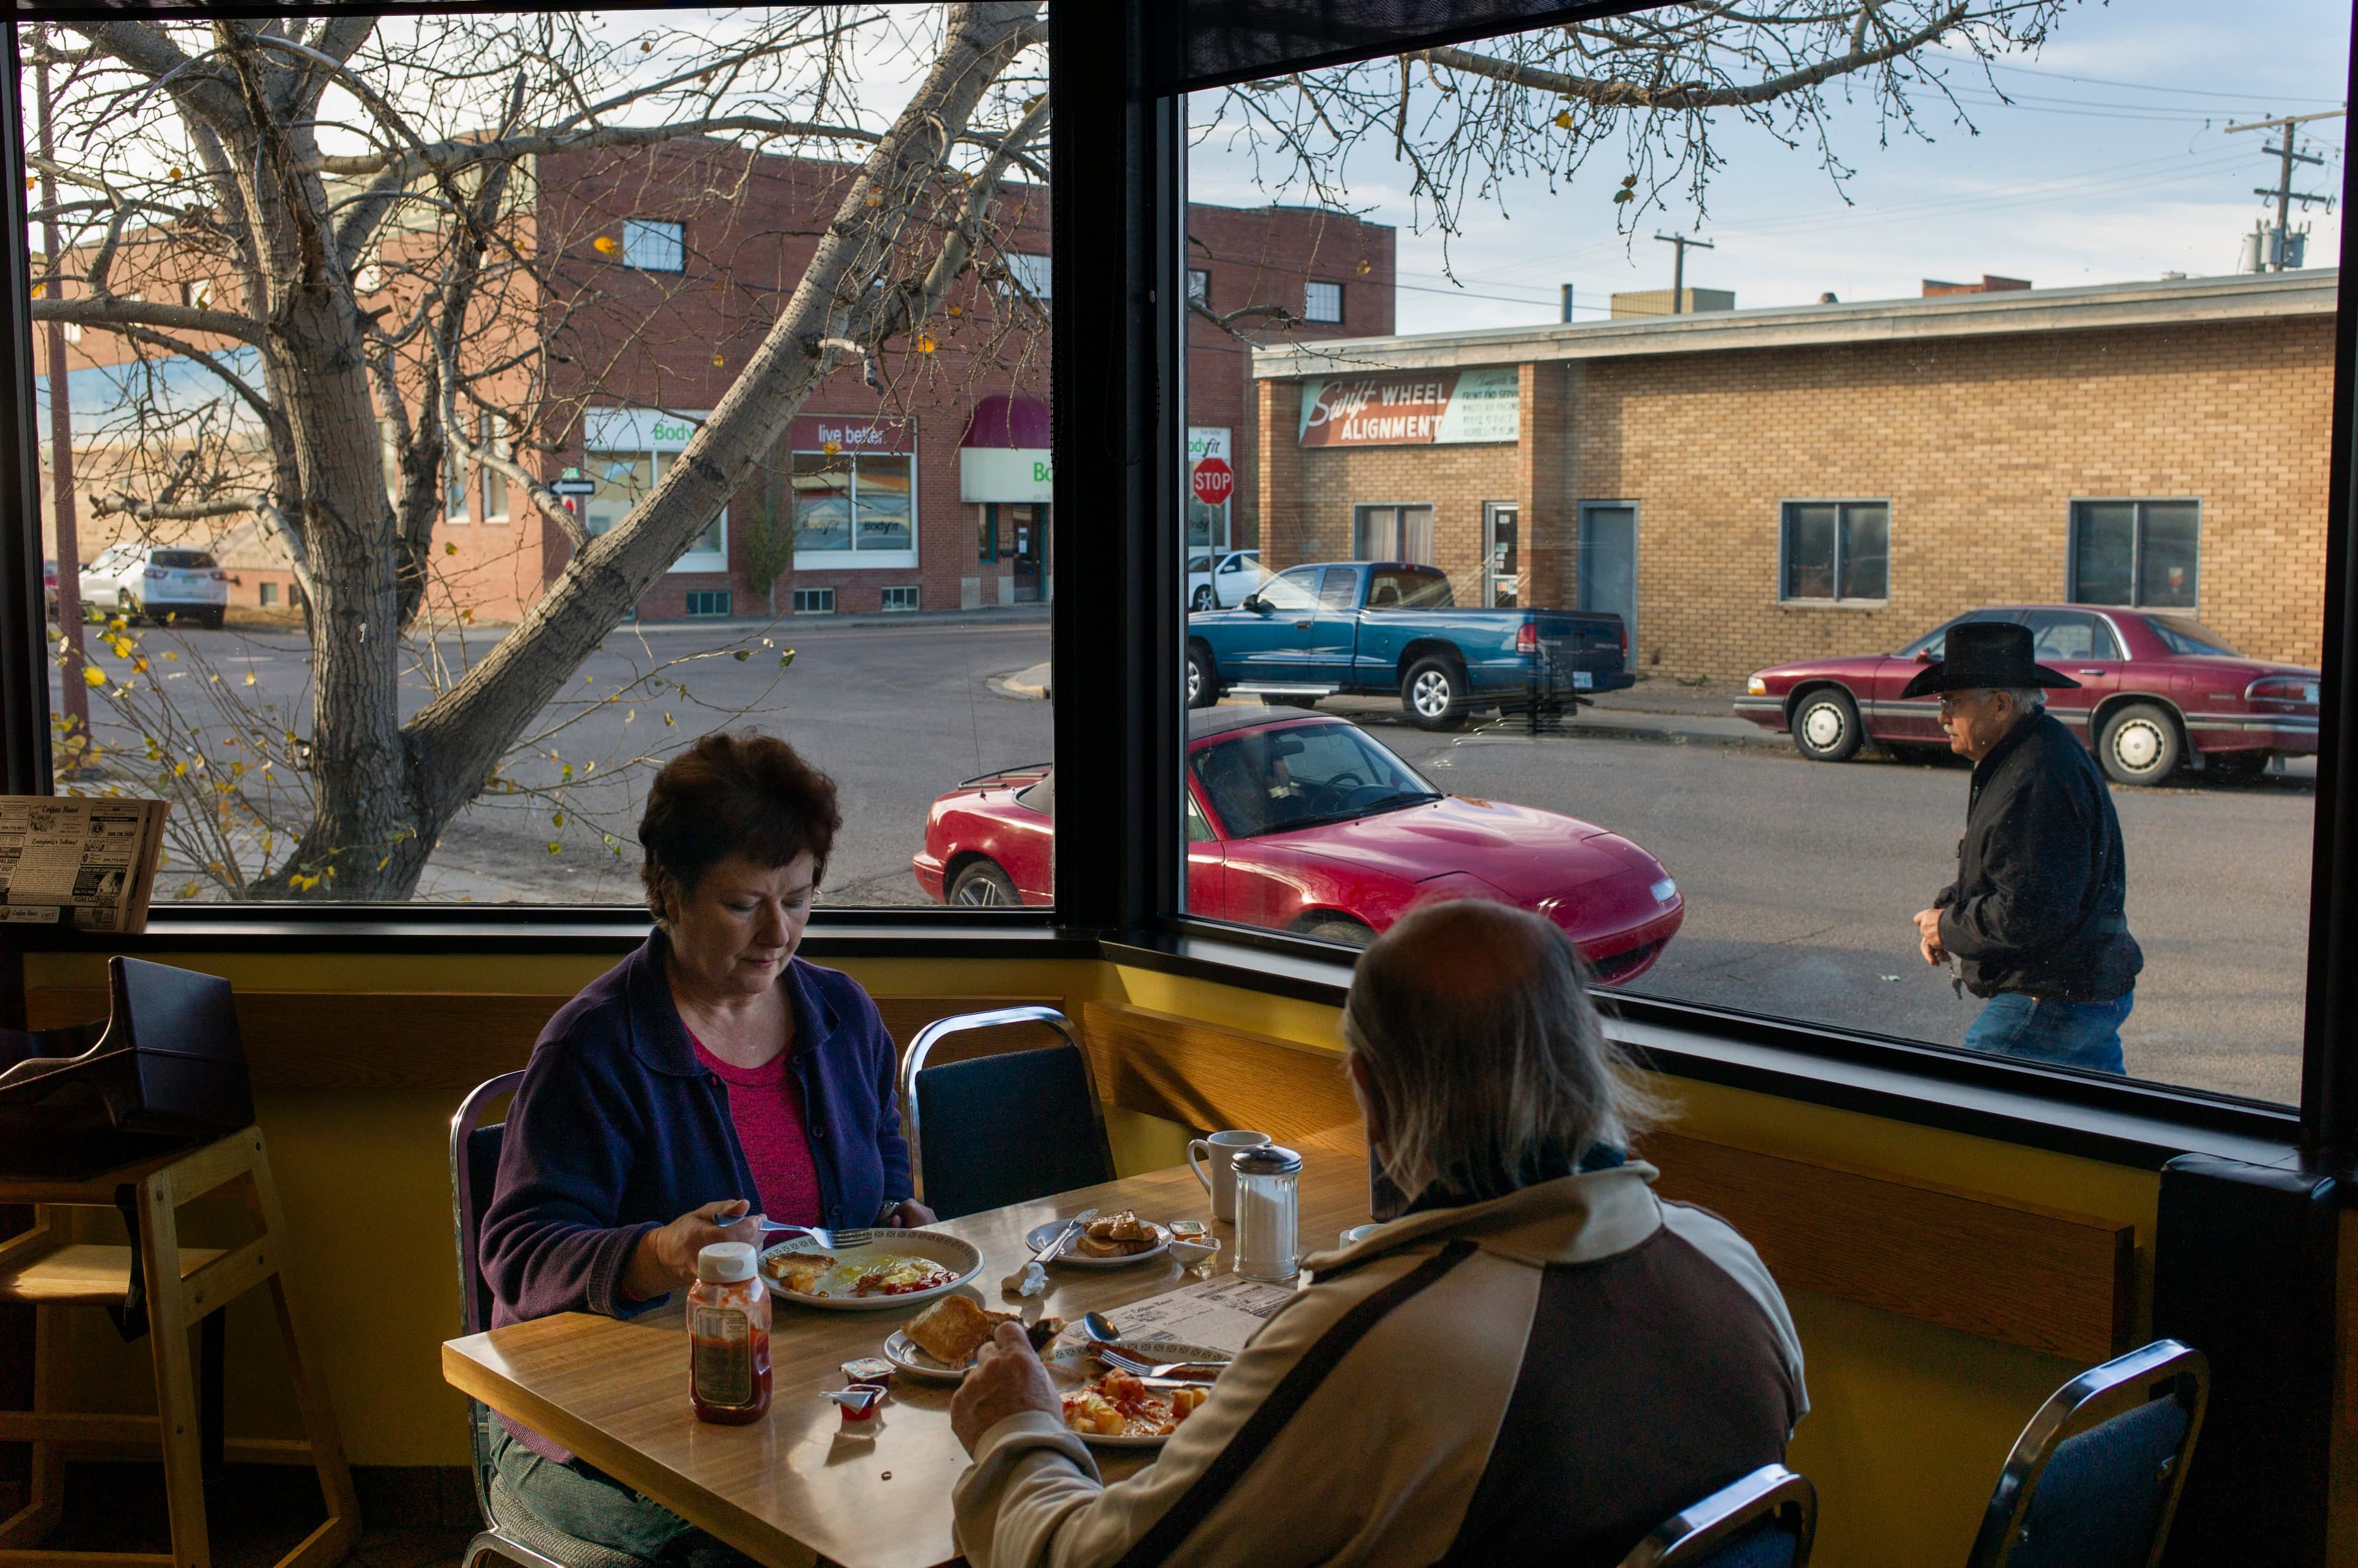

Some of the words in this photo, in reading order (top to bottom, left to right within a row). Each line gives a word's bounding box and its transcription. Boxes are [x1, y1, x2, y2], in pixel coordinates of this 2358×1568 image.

[1307, 379, 1377, 427] Swift
[1382, 383, 1447, 406] WHEEL
[819, 424, 842, 443] live
[845, 425, 884, 444] better
[1341, 414, 1443, 440] ALIGNMENT
[1195, 472, 1231, 490] STOP
